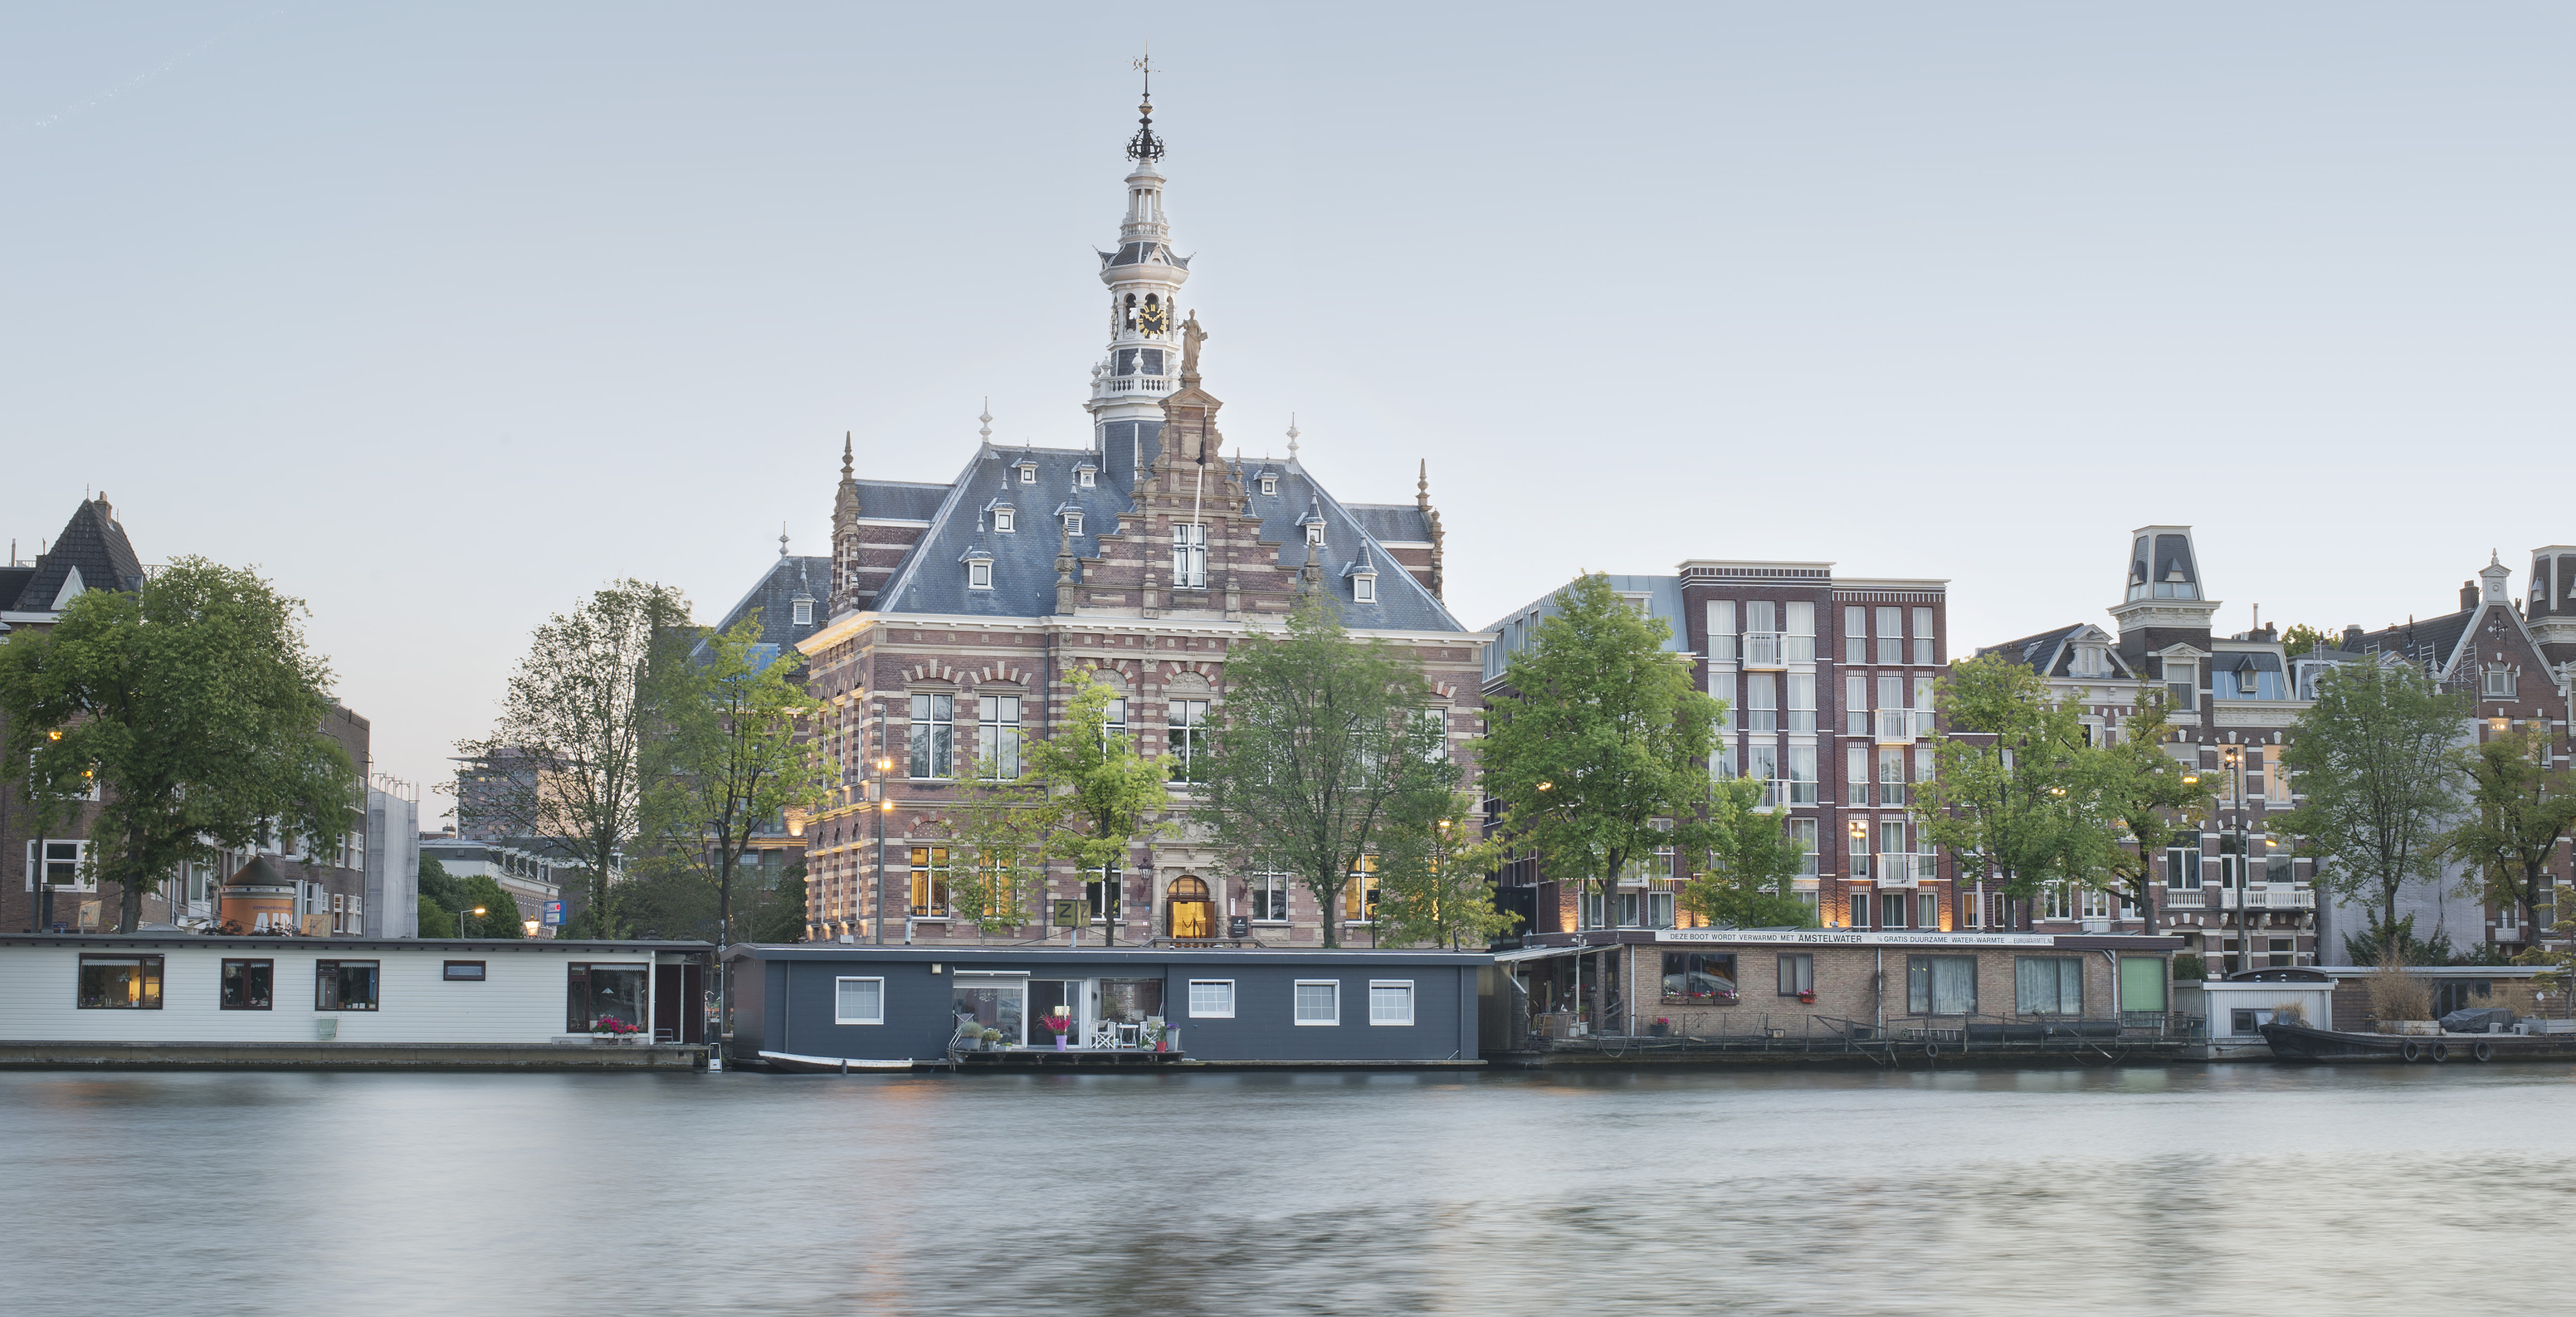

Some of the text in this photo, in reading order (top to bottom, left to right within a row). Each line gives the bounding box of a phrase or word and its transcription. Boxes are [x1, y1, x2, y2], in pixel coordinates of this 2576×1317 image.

[1059, 903, 1071, 918] Z
[1798, 934, 1862, 943] AMSTELWATER
[1910, 935, 1948, 944] DUURZAME
